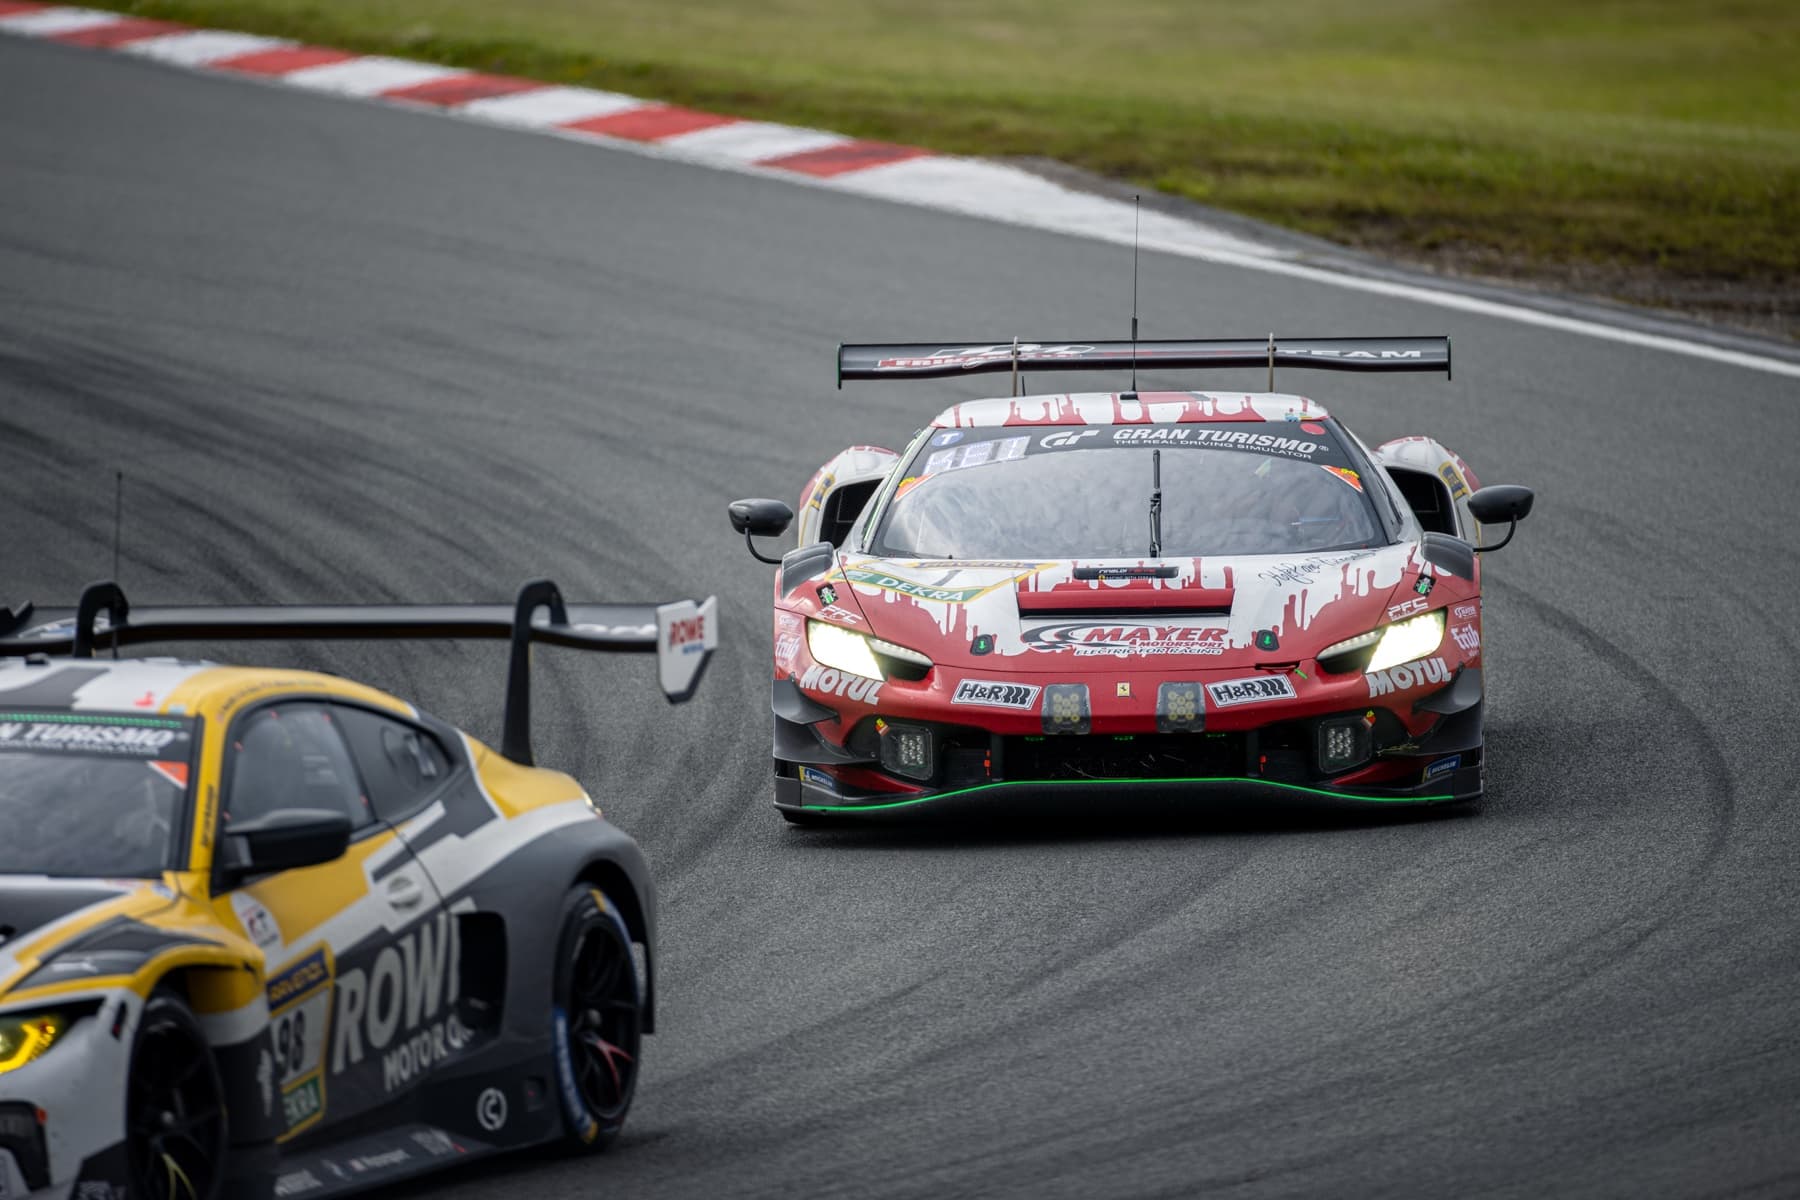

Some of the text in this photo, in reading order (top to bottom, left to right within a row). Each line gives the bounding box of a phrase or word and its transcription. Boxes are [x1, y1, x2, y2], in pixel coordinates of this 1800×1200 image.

[1113, 428, 1318, 454] GRAN TURISMO
[1180, 440, 1234, 448] DRIVING
[1236, 443, 1312, 460] SIMULATOR
[878, 576, 966, 601] DEKRA
[1083, 627, 1229, 642] MAYER
[1076, 648, 1135, 656] ELECTRIC
[799, 664, 885, 706] MOTUL
[1365, 657, 1453, 699] MOTUL
[958, 682, 1004, 702] H&R
[1212, 681, 1260, 702] H&R
[384, 1021, 448, 1092] MOTOR
